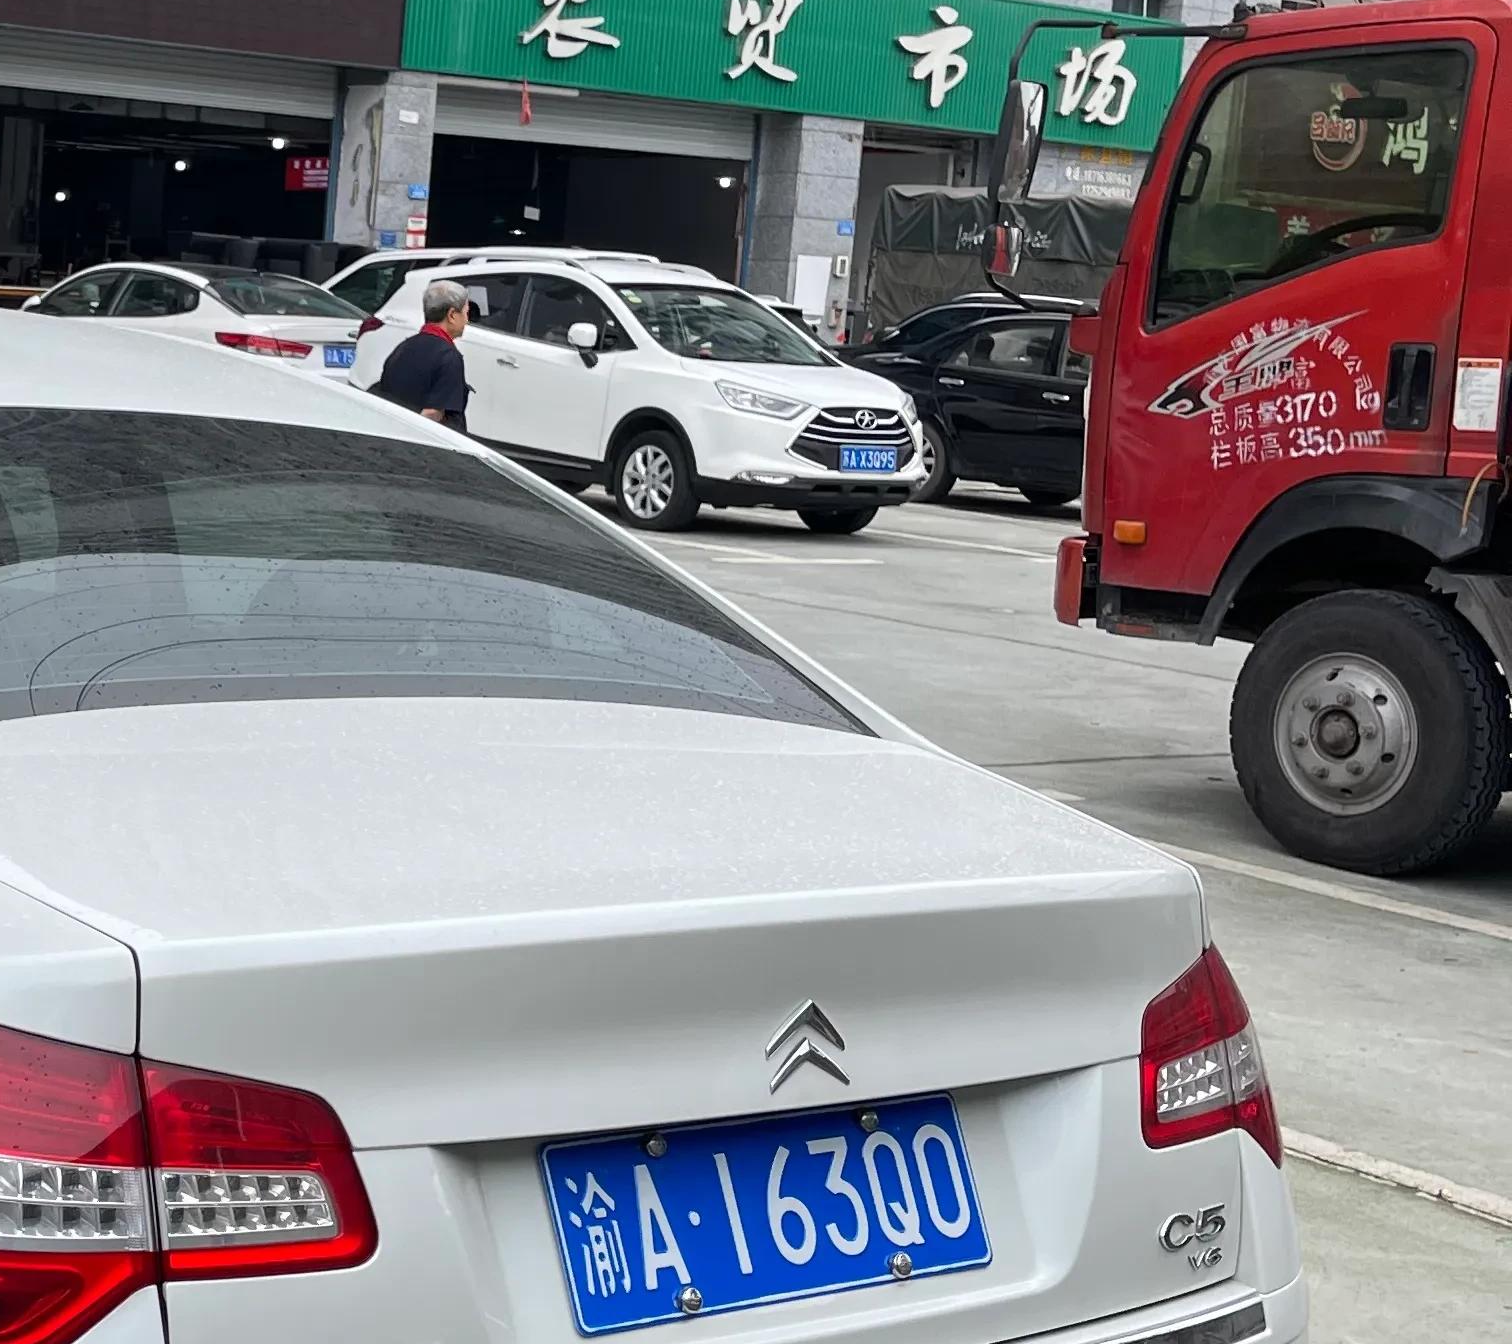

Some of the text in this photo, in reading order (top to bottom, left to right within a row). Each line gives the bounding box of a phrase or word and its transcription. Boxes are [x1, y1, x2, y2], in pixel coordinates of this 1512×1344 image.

[564, 1124, 971, 1298] 渝A·163Q0
[1159, 1202, 1226, 1252] C5
[1188, 1246, 1222, 1271] V6
